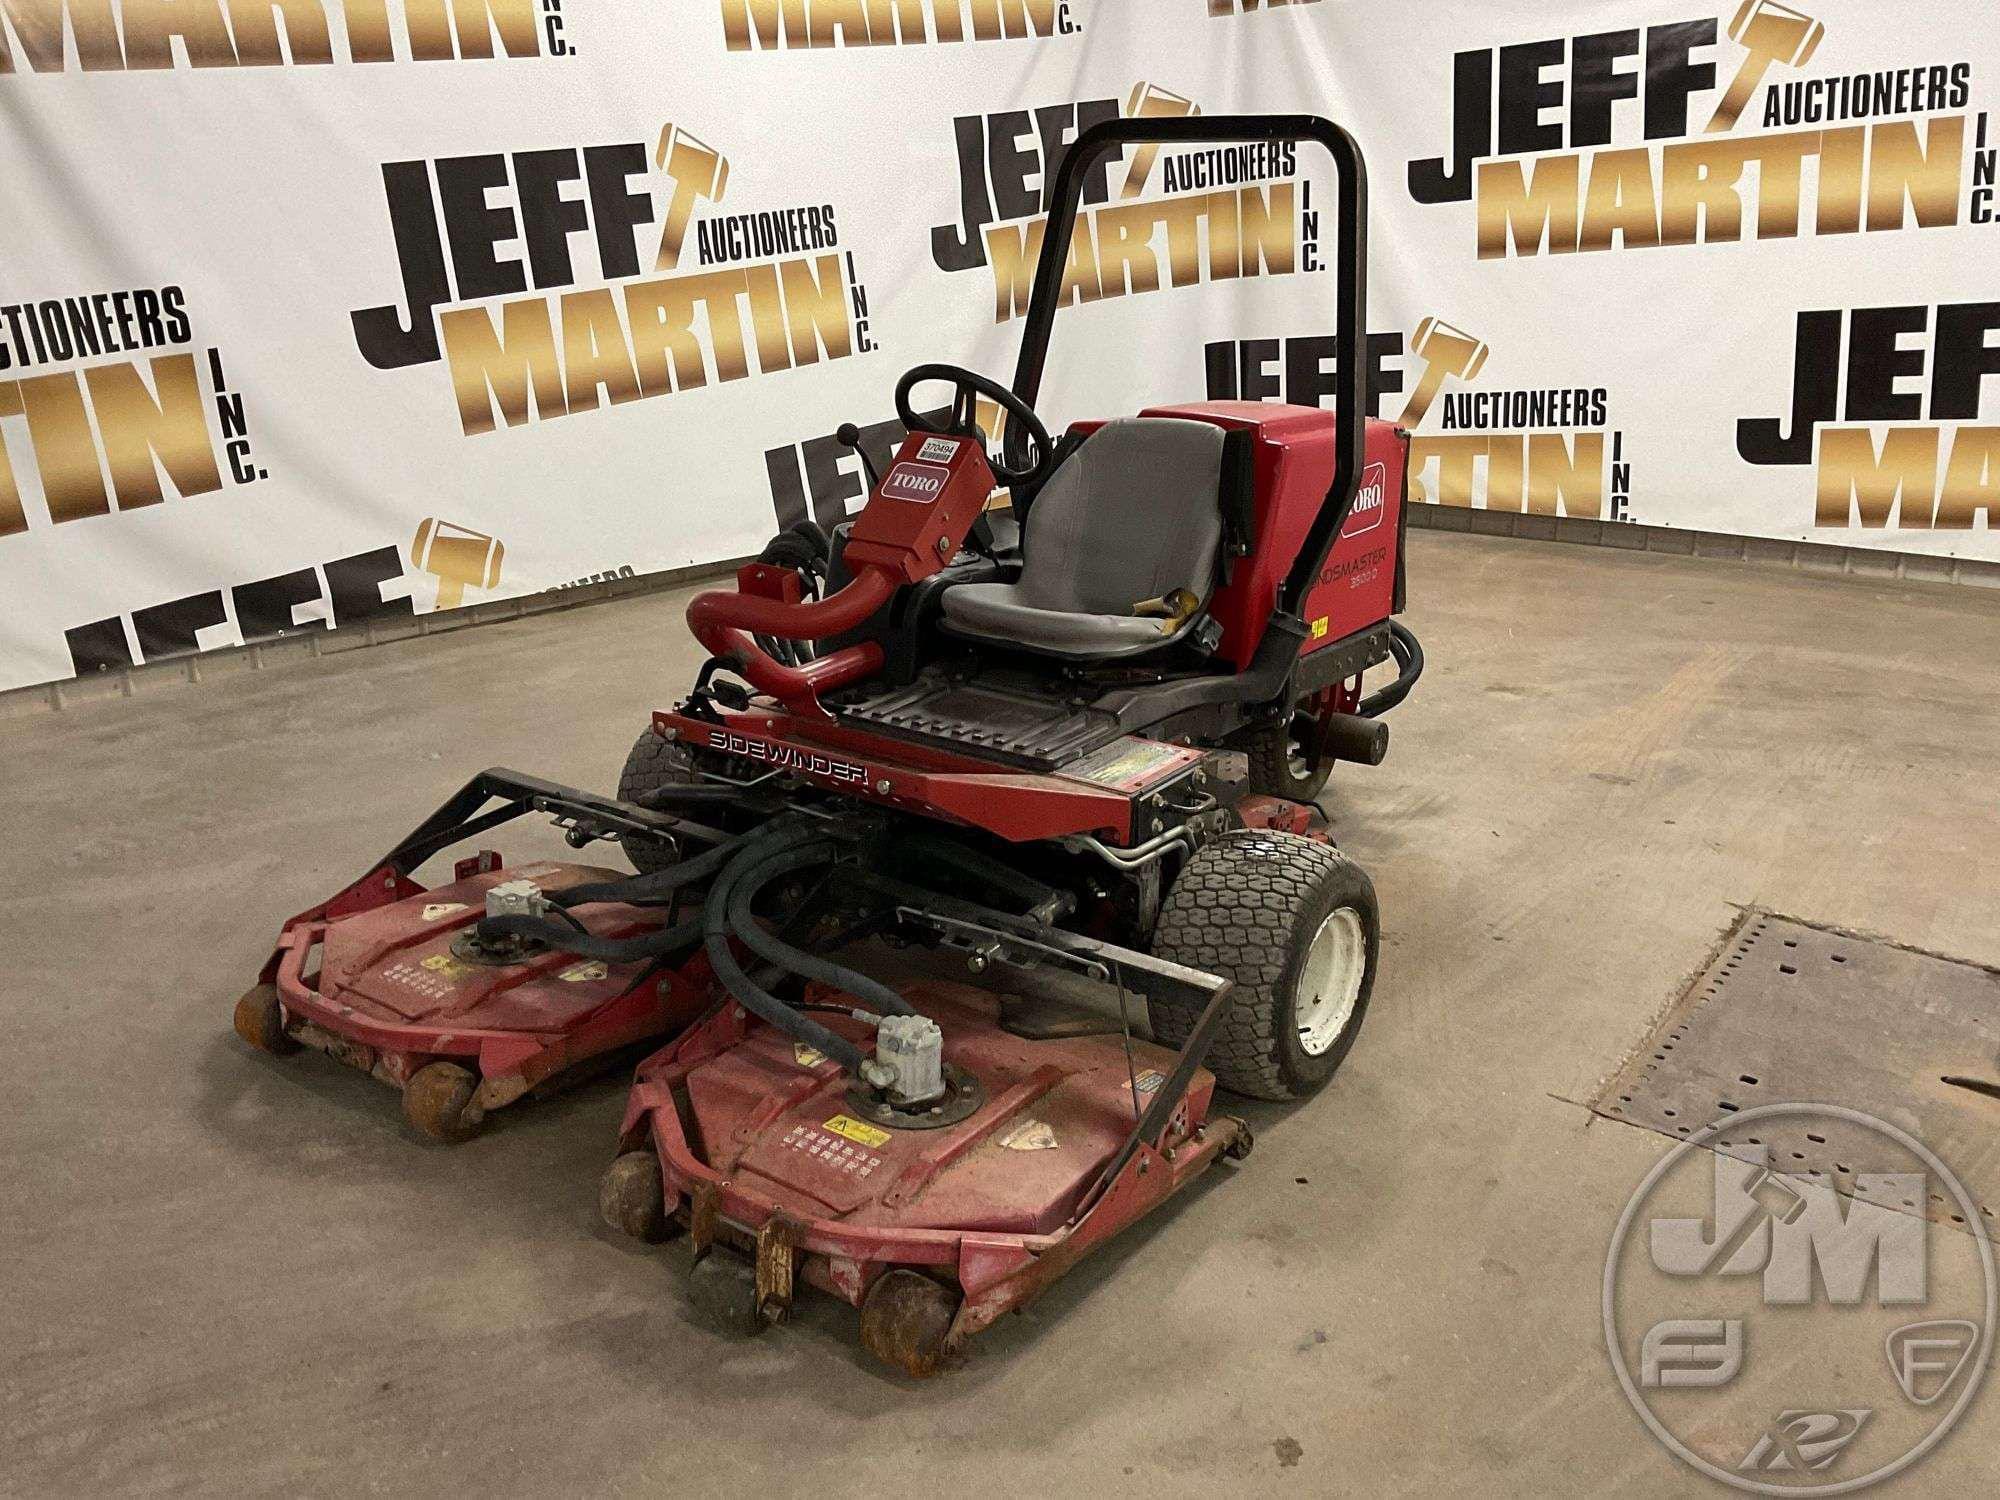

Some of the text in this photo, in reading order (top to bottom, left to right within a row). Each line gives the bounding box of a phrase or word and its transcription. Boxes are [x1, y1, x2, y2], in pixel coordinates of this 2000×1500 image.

[1408, 17, 1718, 204] JEFF
[1763, 63, 1970, 128] AUCTIONEERS
[1163, 140, 1296, 193] AUCTIONEERS
[1477, 115, 1965, 260] MARTIN
[350, 143, 655, 370] JEFF
[699, 204, 837, 265] AUCTIONEERS
[986, 183, 1295, 324] MARTIN
[1302, 180, 1326, 272] INC.
[440, 254, 852, 437] MARTIN
[845, 251, 878, 353] INC.
[207, 347, 268, 485] INC.
[1442, 388, 1607, 429] AUCTIONEERS
[892, 473, 939, 492] TORO
[710, 731, 869, 785] SIDEWINDER
